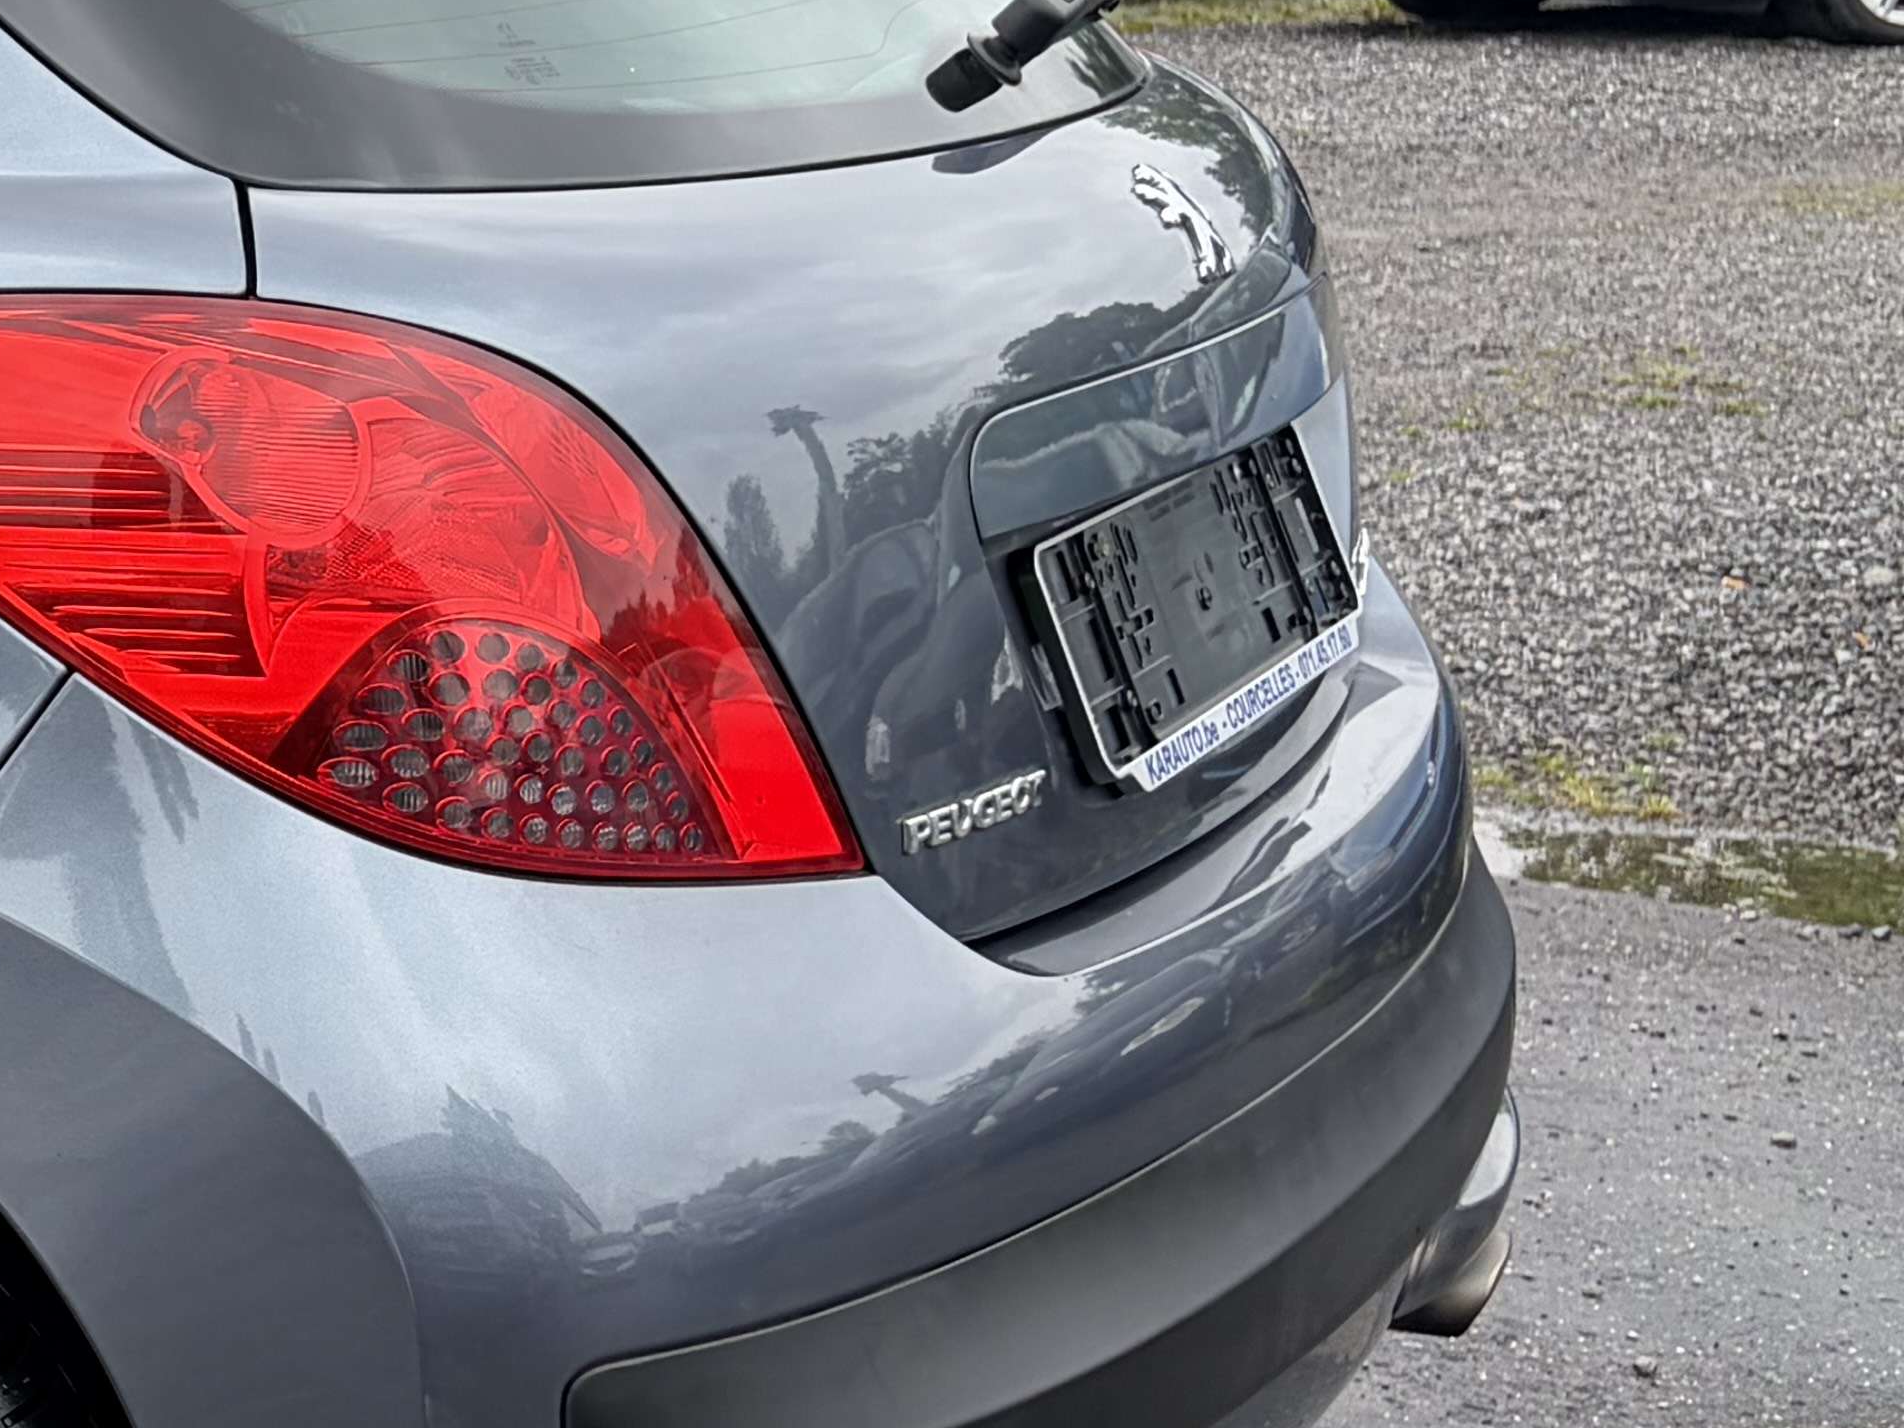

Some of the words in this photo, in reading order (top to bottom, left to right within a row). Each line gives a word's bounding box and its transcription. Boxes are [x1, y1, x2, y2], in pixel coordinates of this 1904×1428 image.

[1144, 721, 1220, 786] KARAUTO.be
[1225, 663, 1297, 730] COURCELLES
[901, 768, 1047, 855] PEUGEOT
